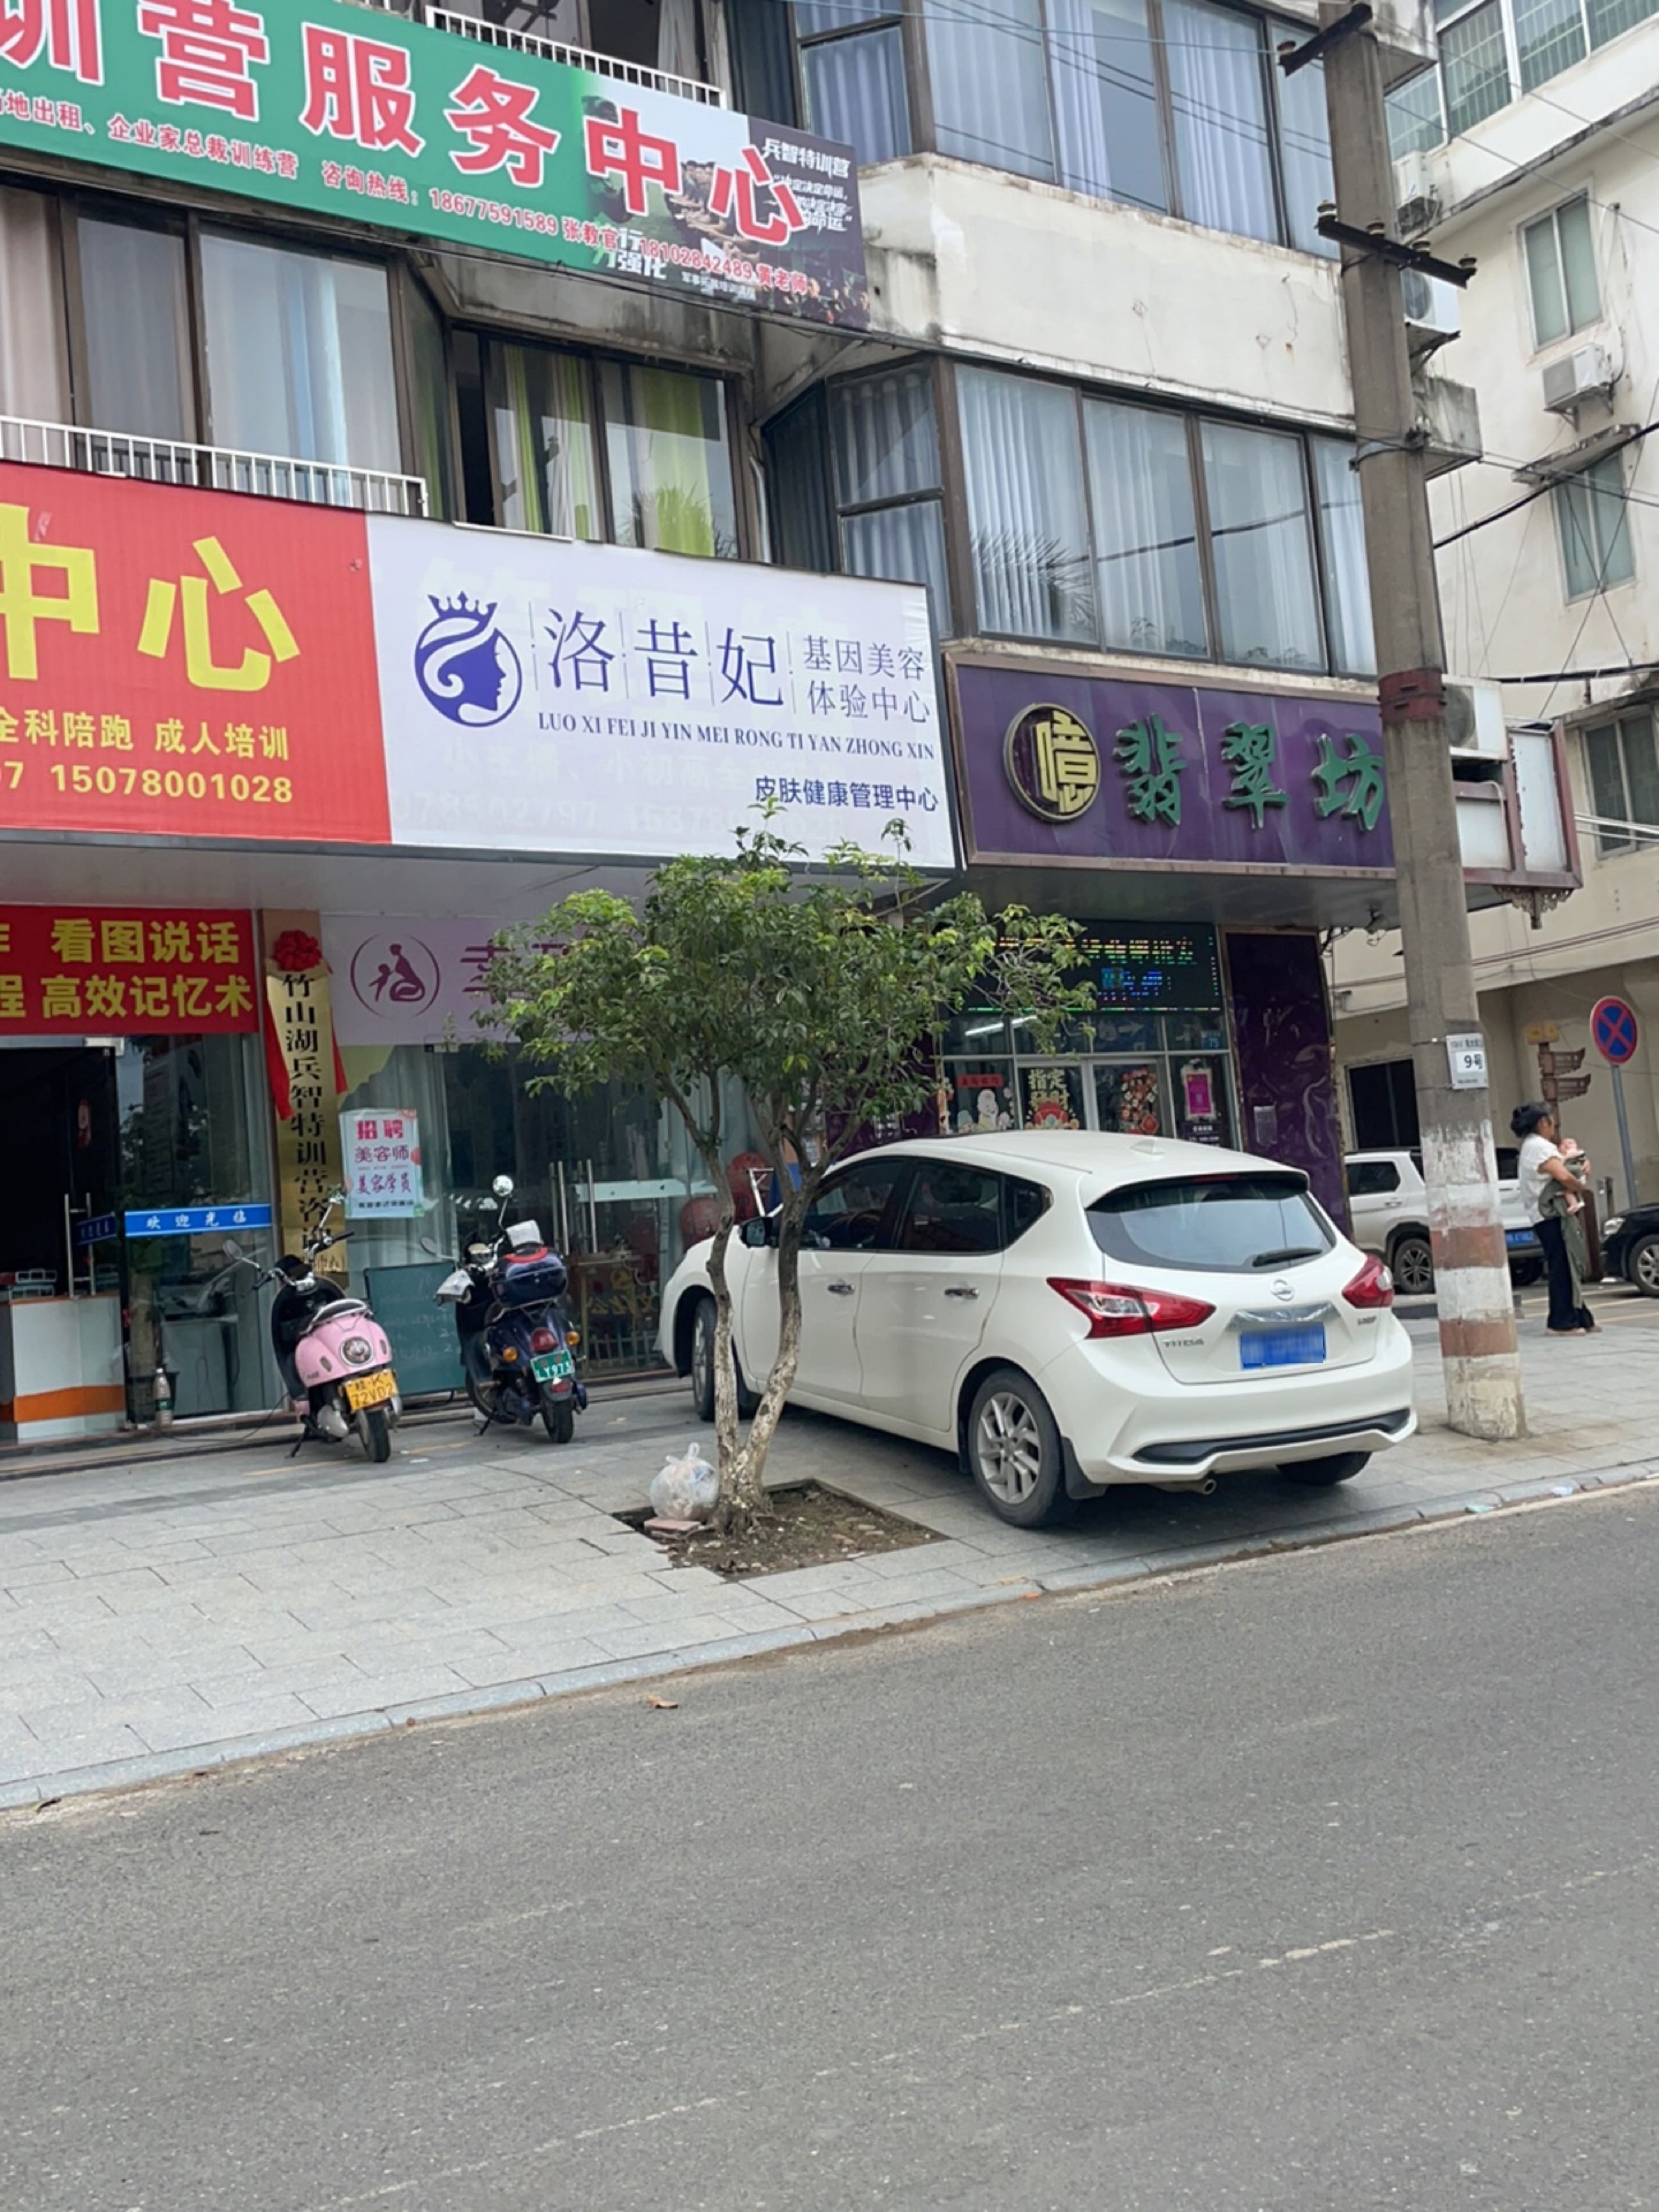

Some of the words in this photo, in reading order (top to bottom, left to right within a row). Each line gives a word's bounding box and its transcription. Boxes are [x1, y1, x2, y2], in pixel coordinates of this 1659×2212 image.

[0, 88, 299, 180] 地出租、企业家总裁训练营
[0, 502, 301, 693] 中心
[543, 608, 784, 705] 洛昔妃
[803, 634, 924, 682] 基因美容
[807, 679, 931, 723] 体验中心
[0, 708, 134, 751] 全科陪跑
[155, 718, 290, 761] 成人培训
[538, 712, 577, 732] LUO
[582, 715, 601, 733] XI
[607, 717, 636, 737] FEI
[640, 721, 656, 738] JI
[661, 722, 692, 741] YIN
[696, 725, 729, 744] MEI
[734, 727, 783, 748] RONG
[787, 733, 803, 750] TI
[807, 733, 841, 752] YAN
[846, 737, 903, 758] ZHONG
[906, 742, 934, 760] XIN
[51, 764, 293, 803] 15078001028
[755, 775, 939, 812] 皮肤健康管理中心
[1112, 712, 1386, 831] 翡翠坊
[50, 918, 241, 964] 看图说话
[40, 974, 253, 1019] 高效记忆术
